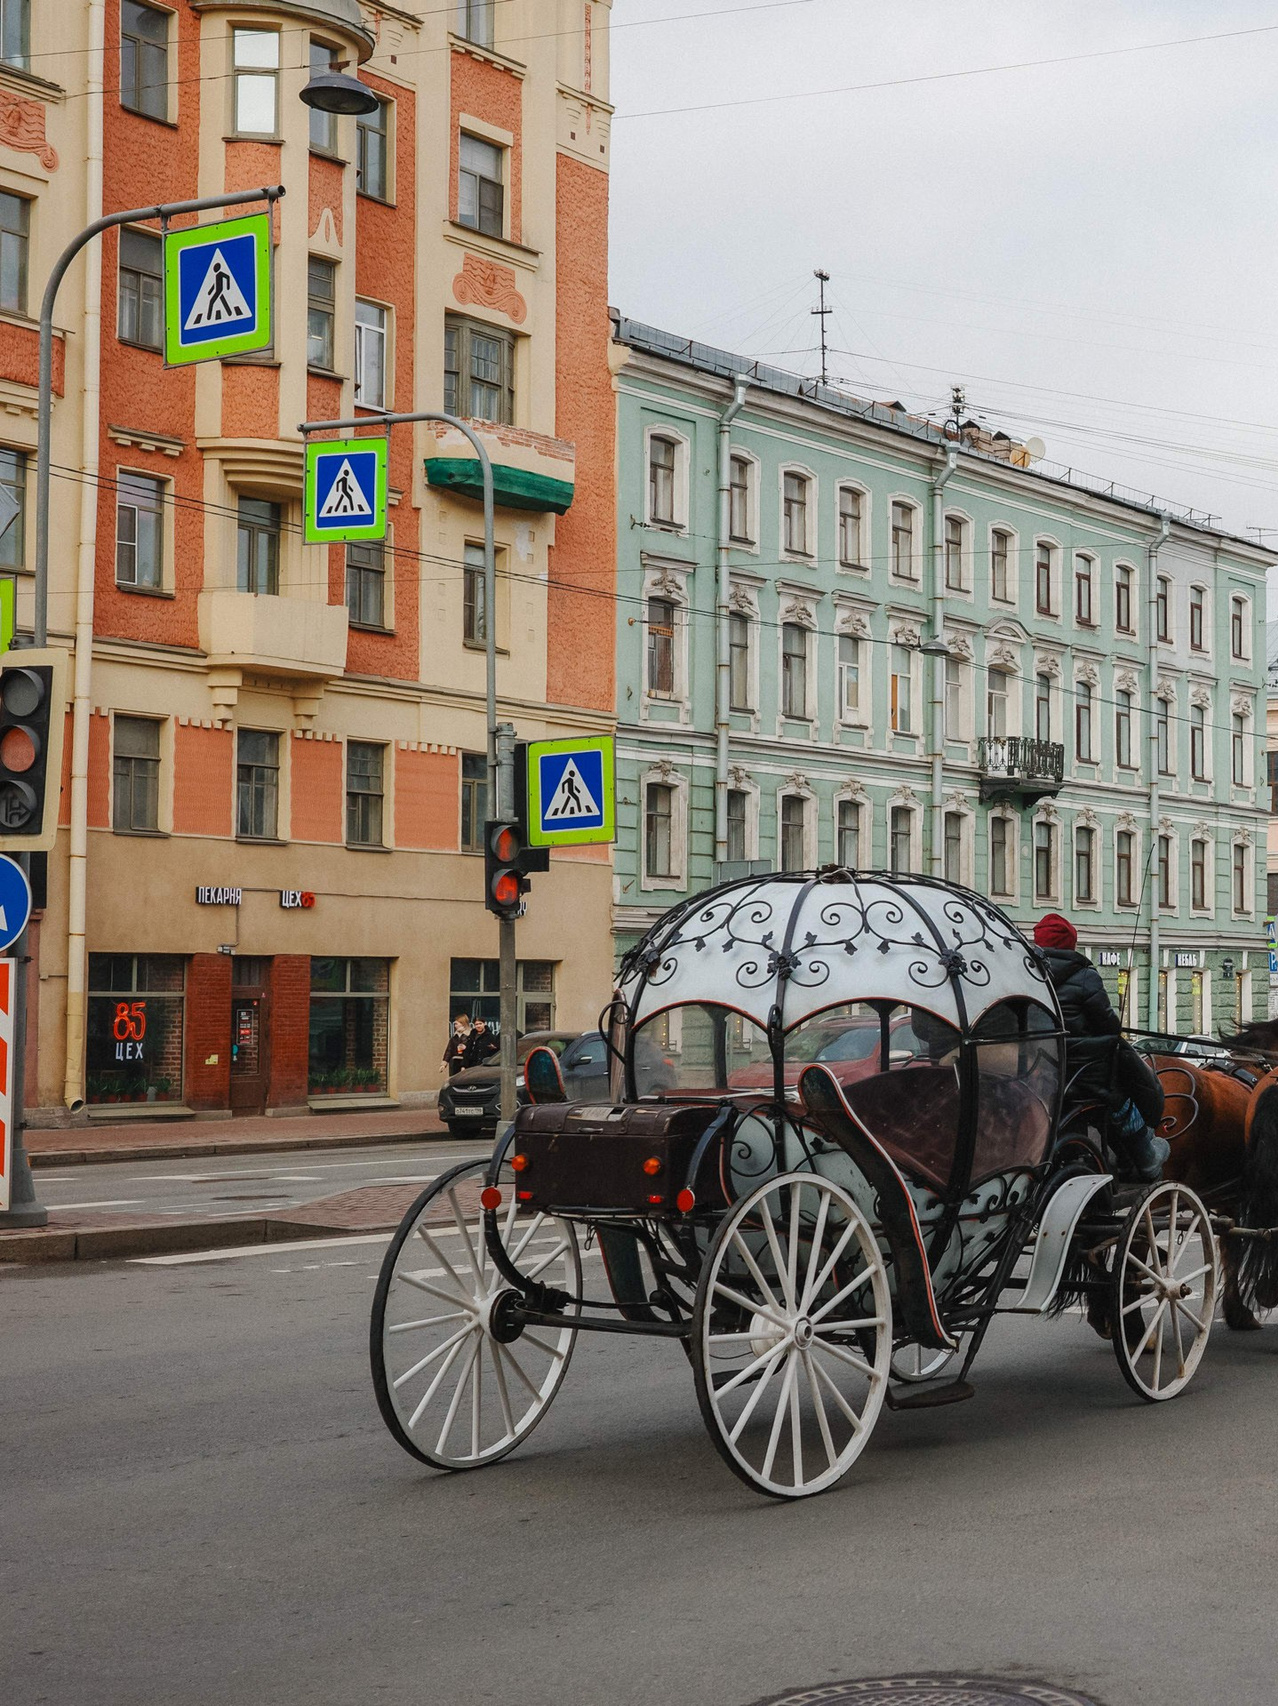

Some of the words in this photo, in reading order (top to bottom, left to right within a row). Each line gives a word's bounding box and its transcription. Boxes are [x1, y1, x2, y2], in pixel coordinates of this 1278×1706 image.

[198, 886, 242, 905] ПЕКАРНЯ
[1102, 952, 1120, 966] КАФЕ
[1178, 953, 1197, 967] КЕБАБ
[113, 1002, 146, 1040] 85
[115, 1042, 144, 1061] ЦЕХ
